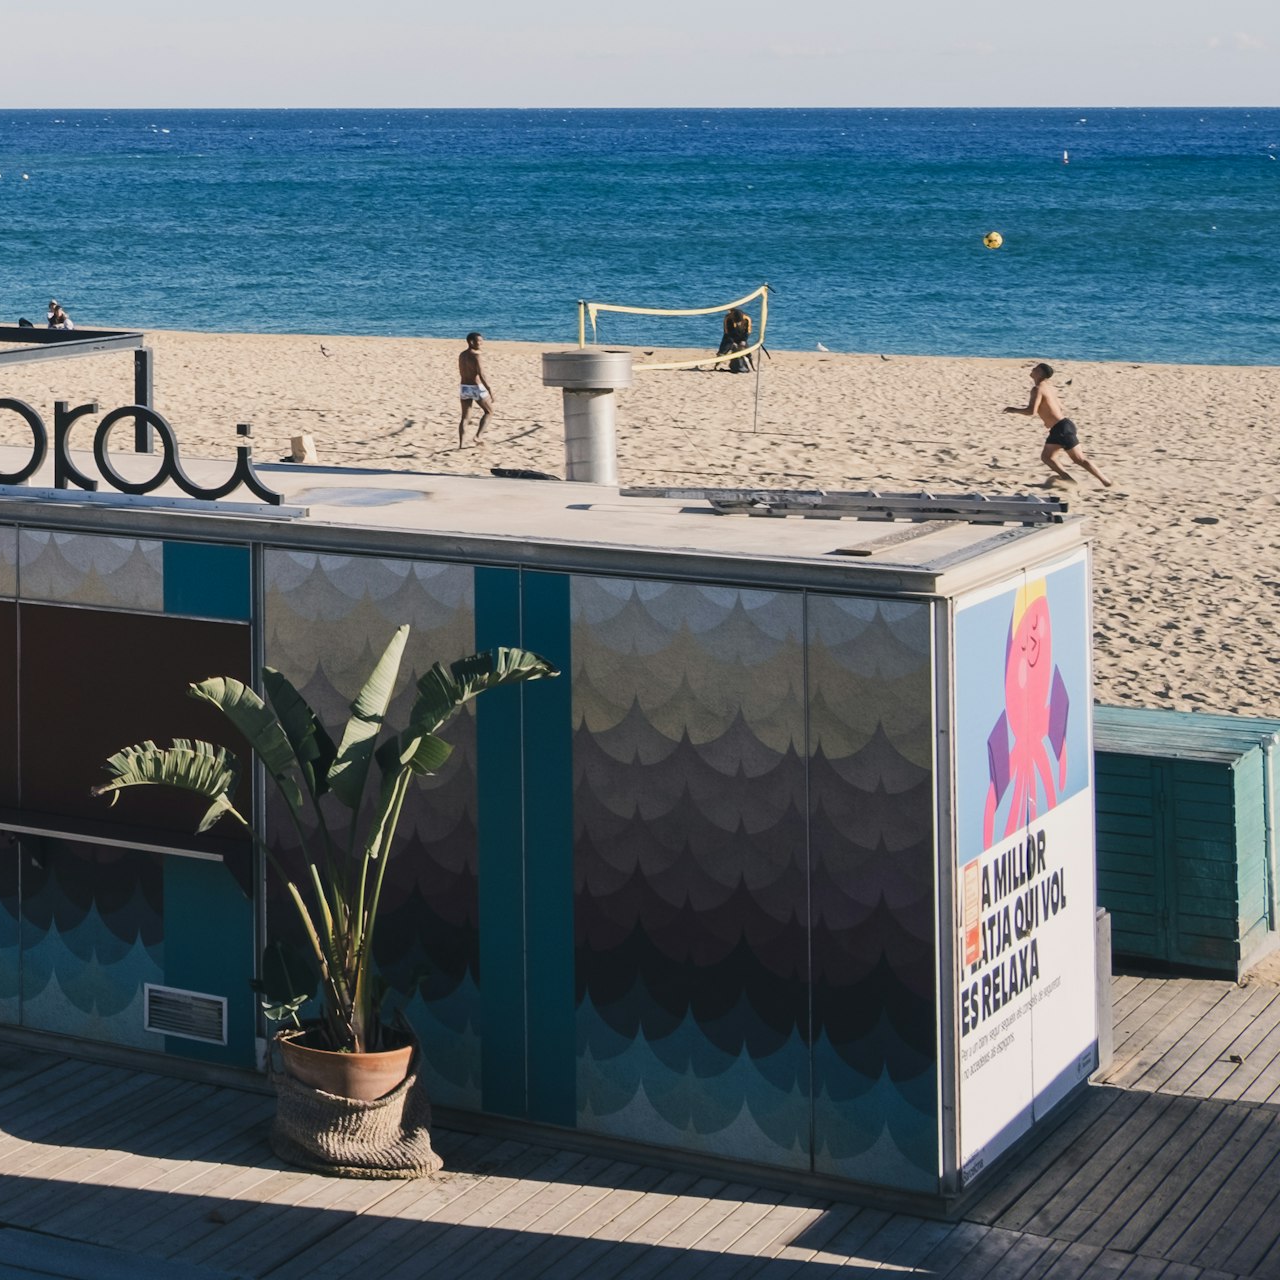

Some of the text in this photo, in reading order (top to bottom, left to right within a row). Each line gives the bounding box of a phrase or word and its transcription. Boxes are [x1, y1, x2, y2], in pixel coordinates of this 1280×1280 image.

[994, 830, 1046, 902] MILLOR
[1014, 885, 1038, 940] QUI
[1042, 867, 1066, 920] VOL
[962, 938, 1039, 1037] ES RELAXA
